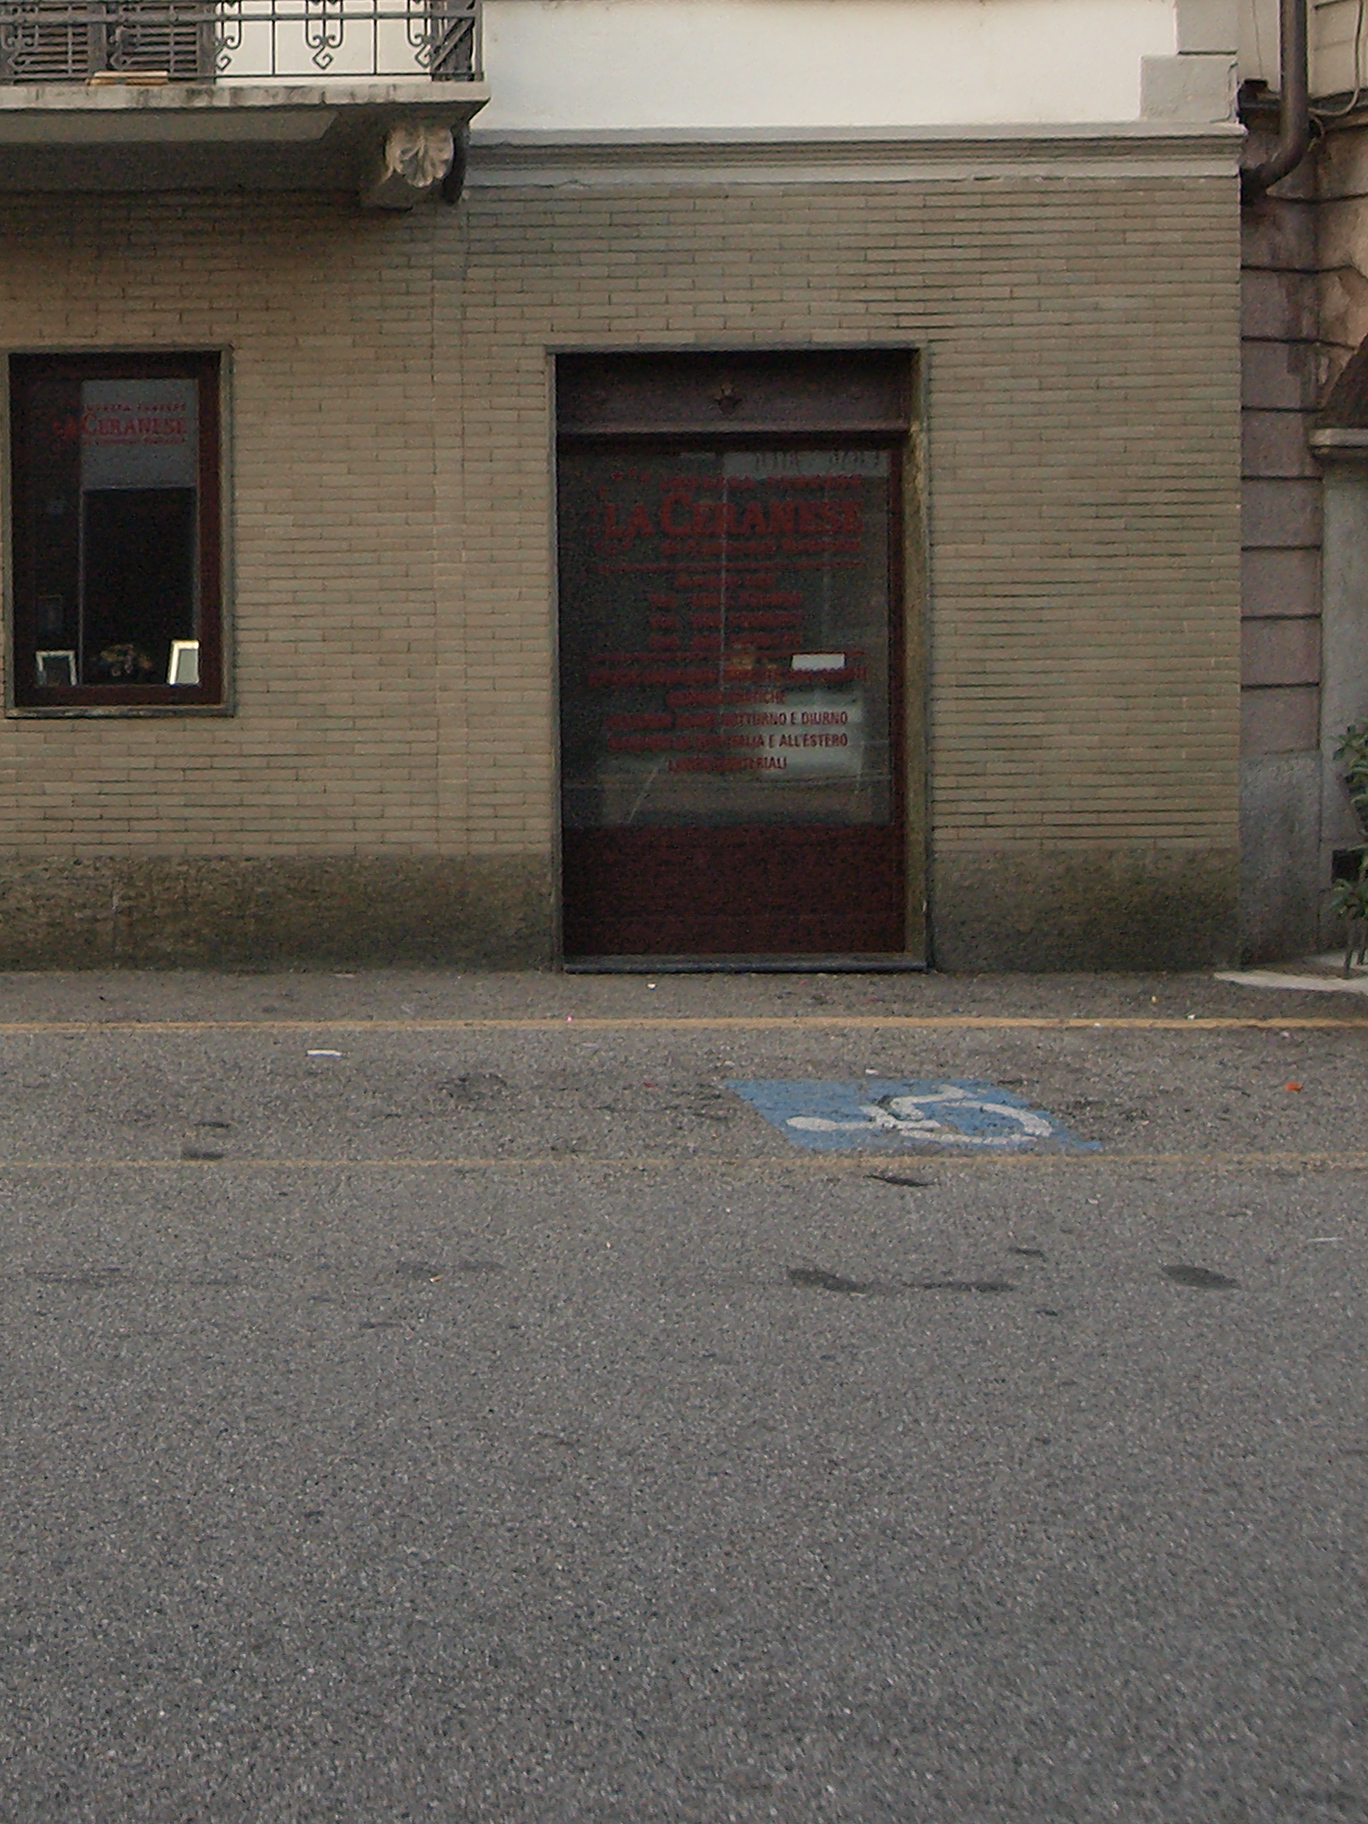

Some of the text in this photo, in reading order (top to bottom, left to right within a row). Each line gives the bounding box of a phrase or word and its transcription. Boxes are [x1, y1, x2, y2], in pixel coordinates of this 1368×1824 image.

[602, 491, 865, 538] LA CERANESE
[801, 710, 848, 725] DIURNO
